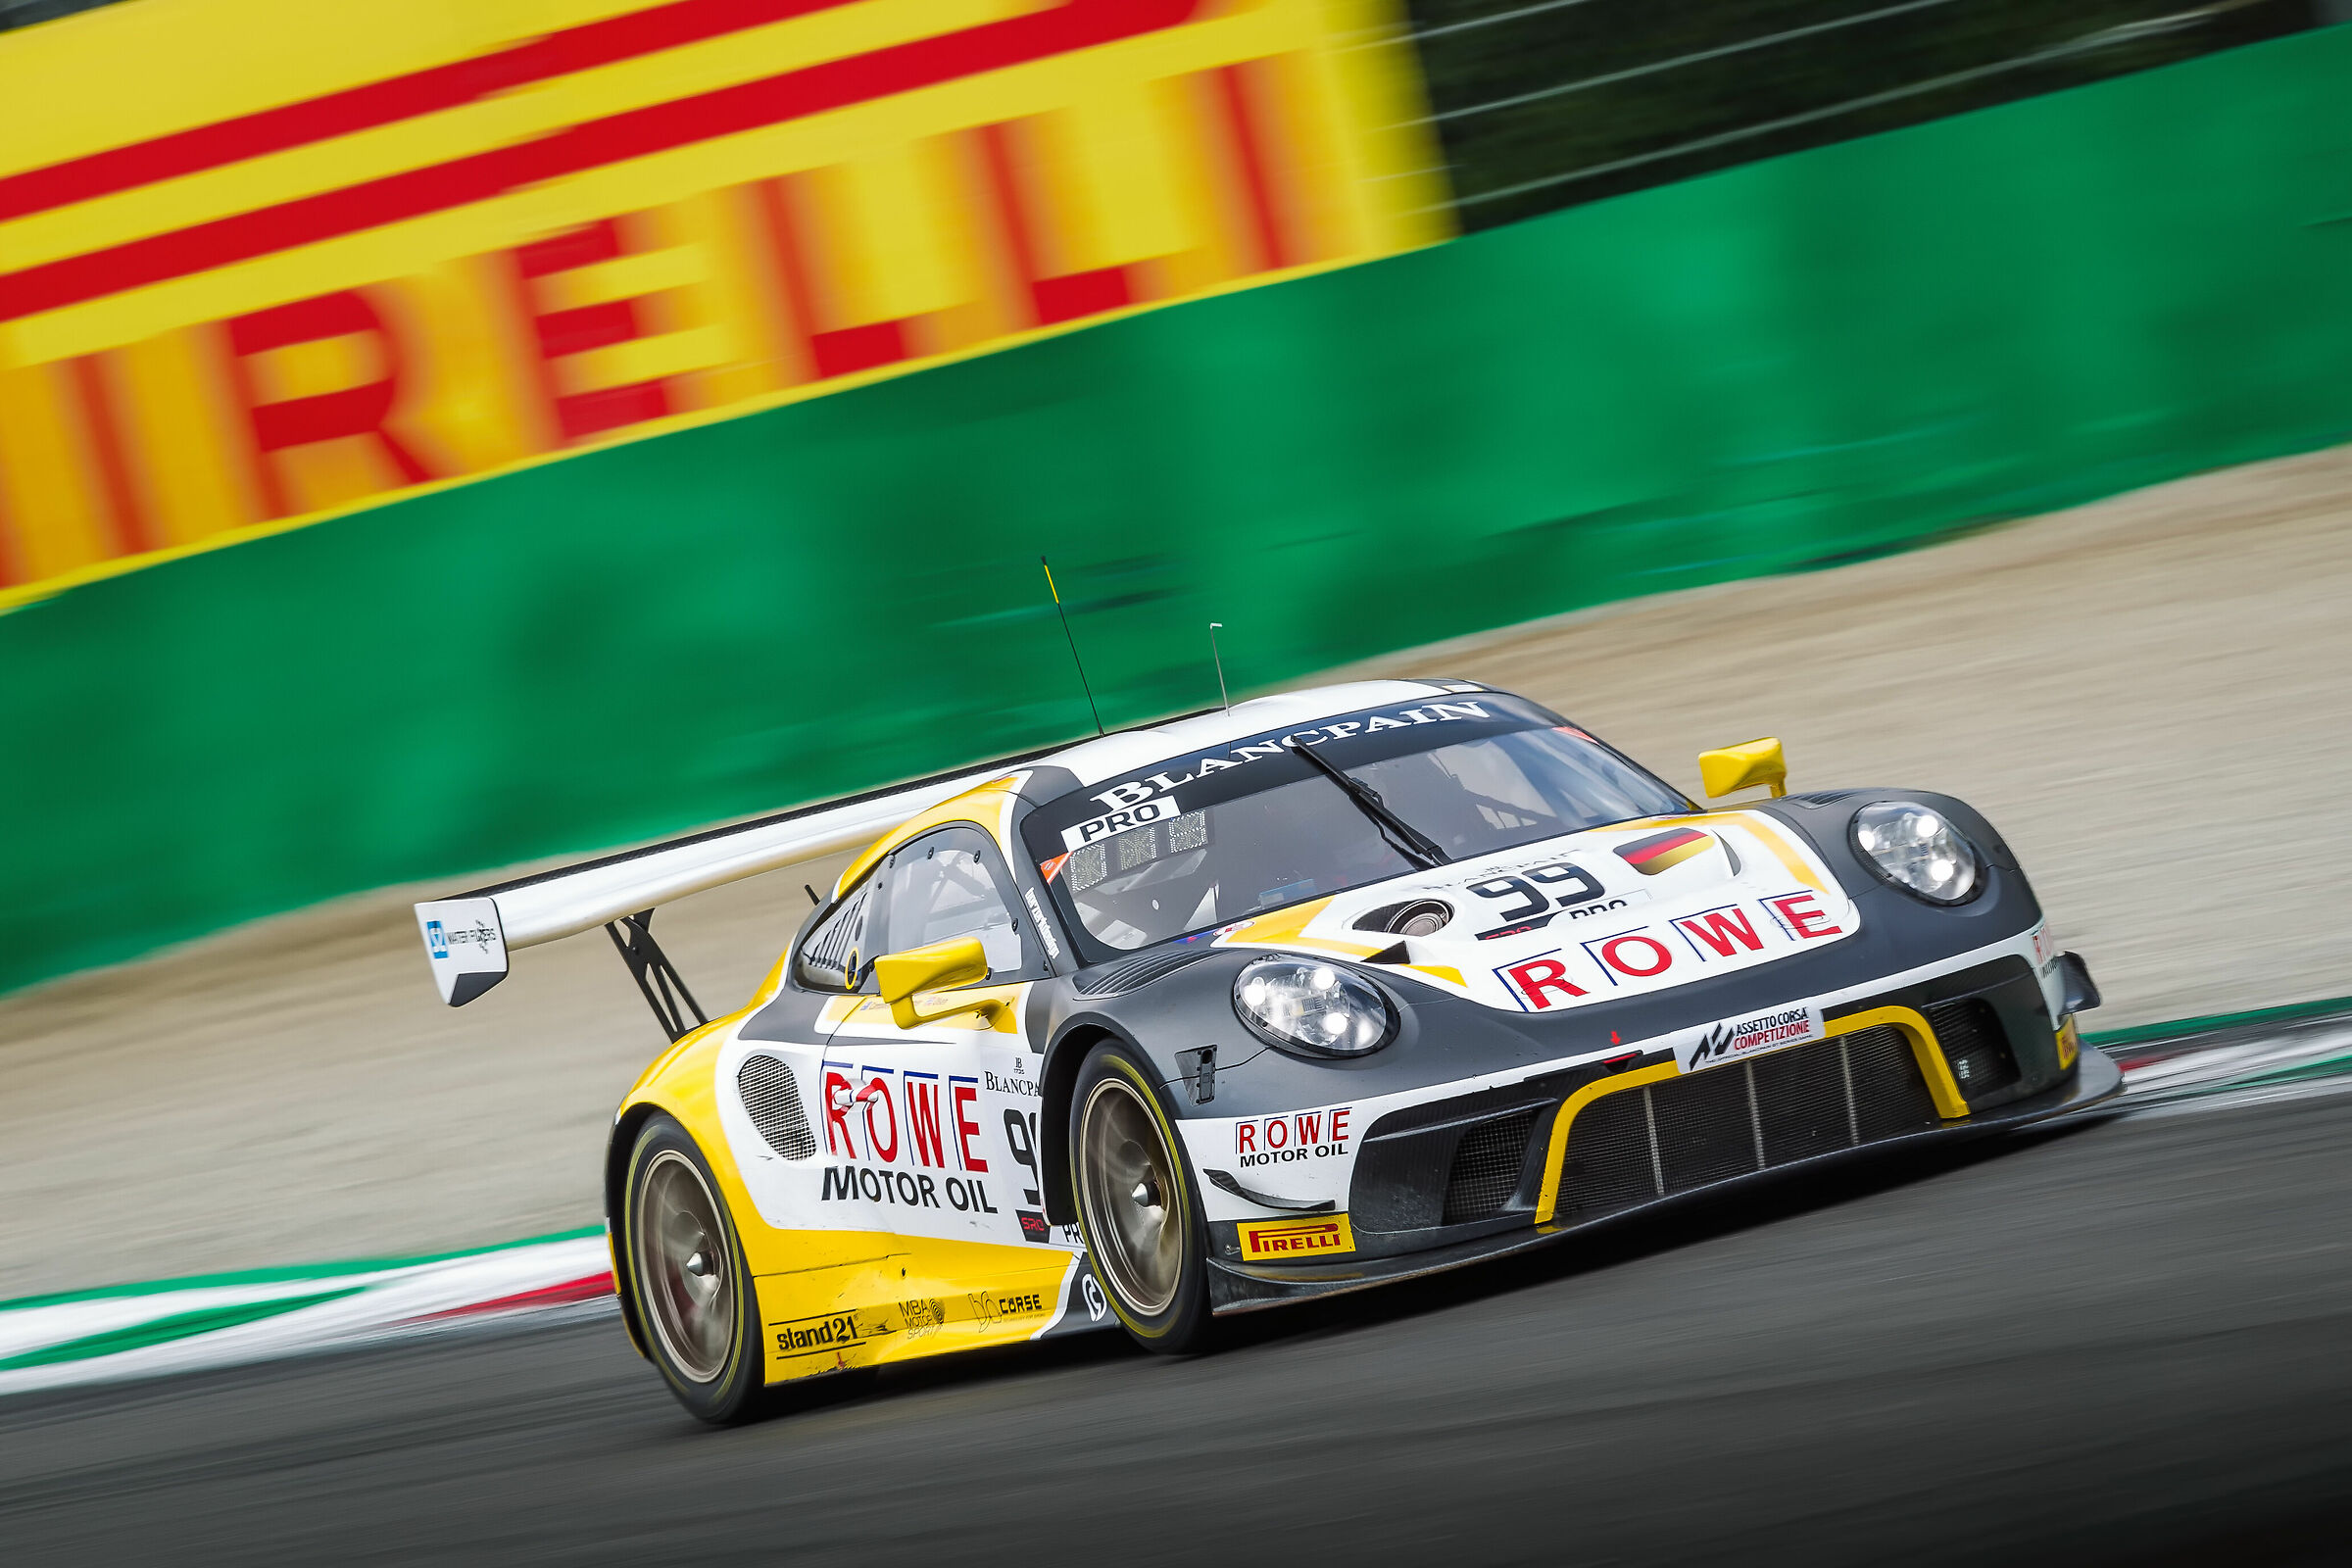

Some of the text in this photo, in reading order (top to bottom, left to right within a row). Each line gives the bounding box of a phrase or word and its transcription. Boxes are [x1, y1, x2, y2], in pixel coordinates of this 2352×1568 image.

[1090, 700, 1492, 811] BLANCPAIN
[1079, 804, 1161, 843] PRO
[1466, 861, 1605, 922] 99
[1507, 894, 1843, 1010] ROWE
[1734, 1019, 1811, 1051] COMPETIZIONE
[1736, 1007, 1808, 1037] ASSETTO CORSA
[825, 1071, 989, 1173] ROWE
[1239, 1109, 1350, 1153] ROWE
[1004, 1107, 1041, 1205] 9
[1240, 1143, 1348, 1167] MOTOR OIL
[821, 1165, 998, 1214] MOTOR OIL
[1249, 1223, 1341, 1253] PIRELLI
[899, 1298, 930, 1317] MBA
[999, 1294, 1043, 1314] CORSE
